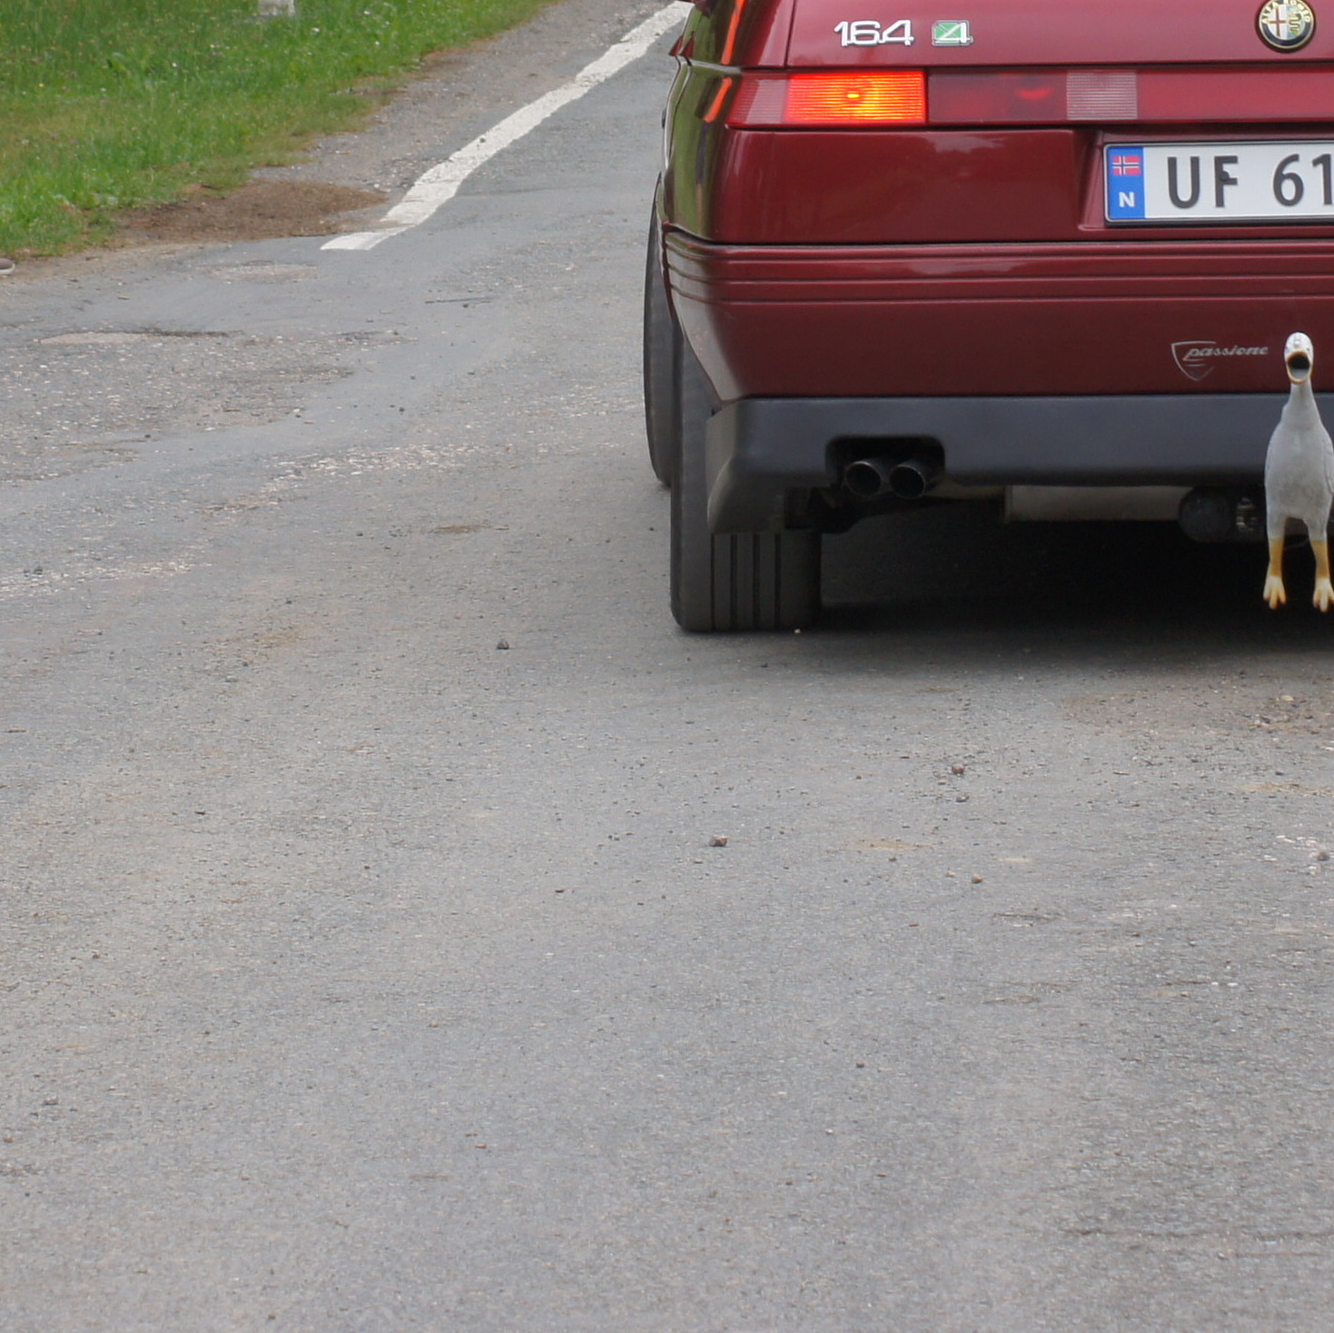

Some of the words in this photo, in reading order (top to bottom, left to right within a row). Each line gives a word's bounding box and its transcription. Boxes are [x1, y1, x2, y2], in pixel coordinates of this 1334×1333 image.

[833, 19, 915, 47] 164
[1167, 155, 1239, 209] UF
[1118, 191, 1135, 208] N
[1182, 345, 1269, 361] passione
